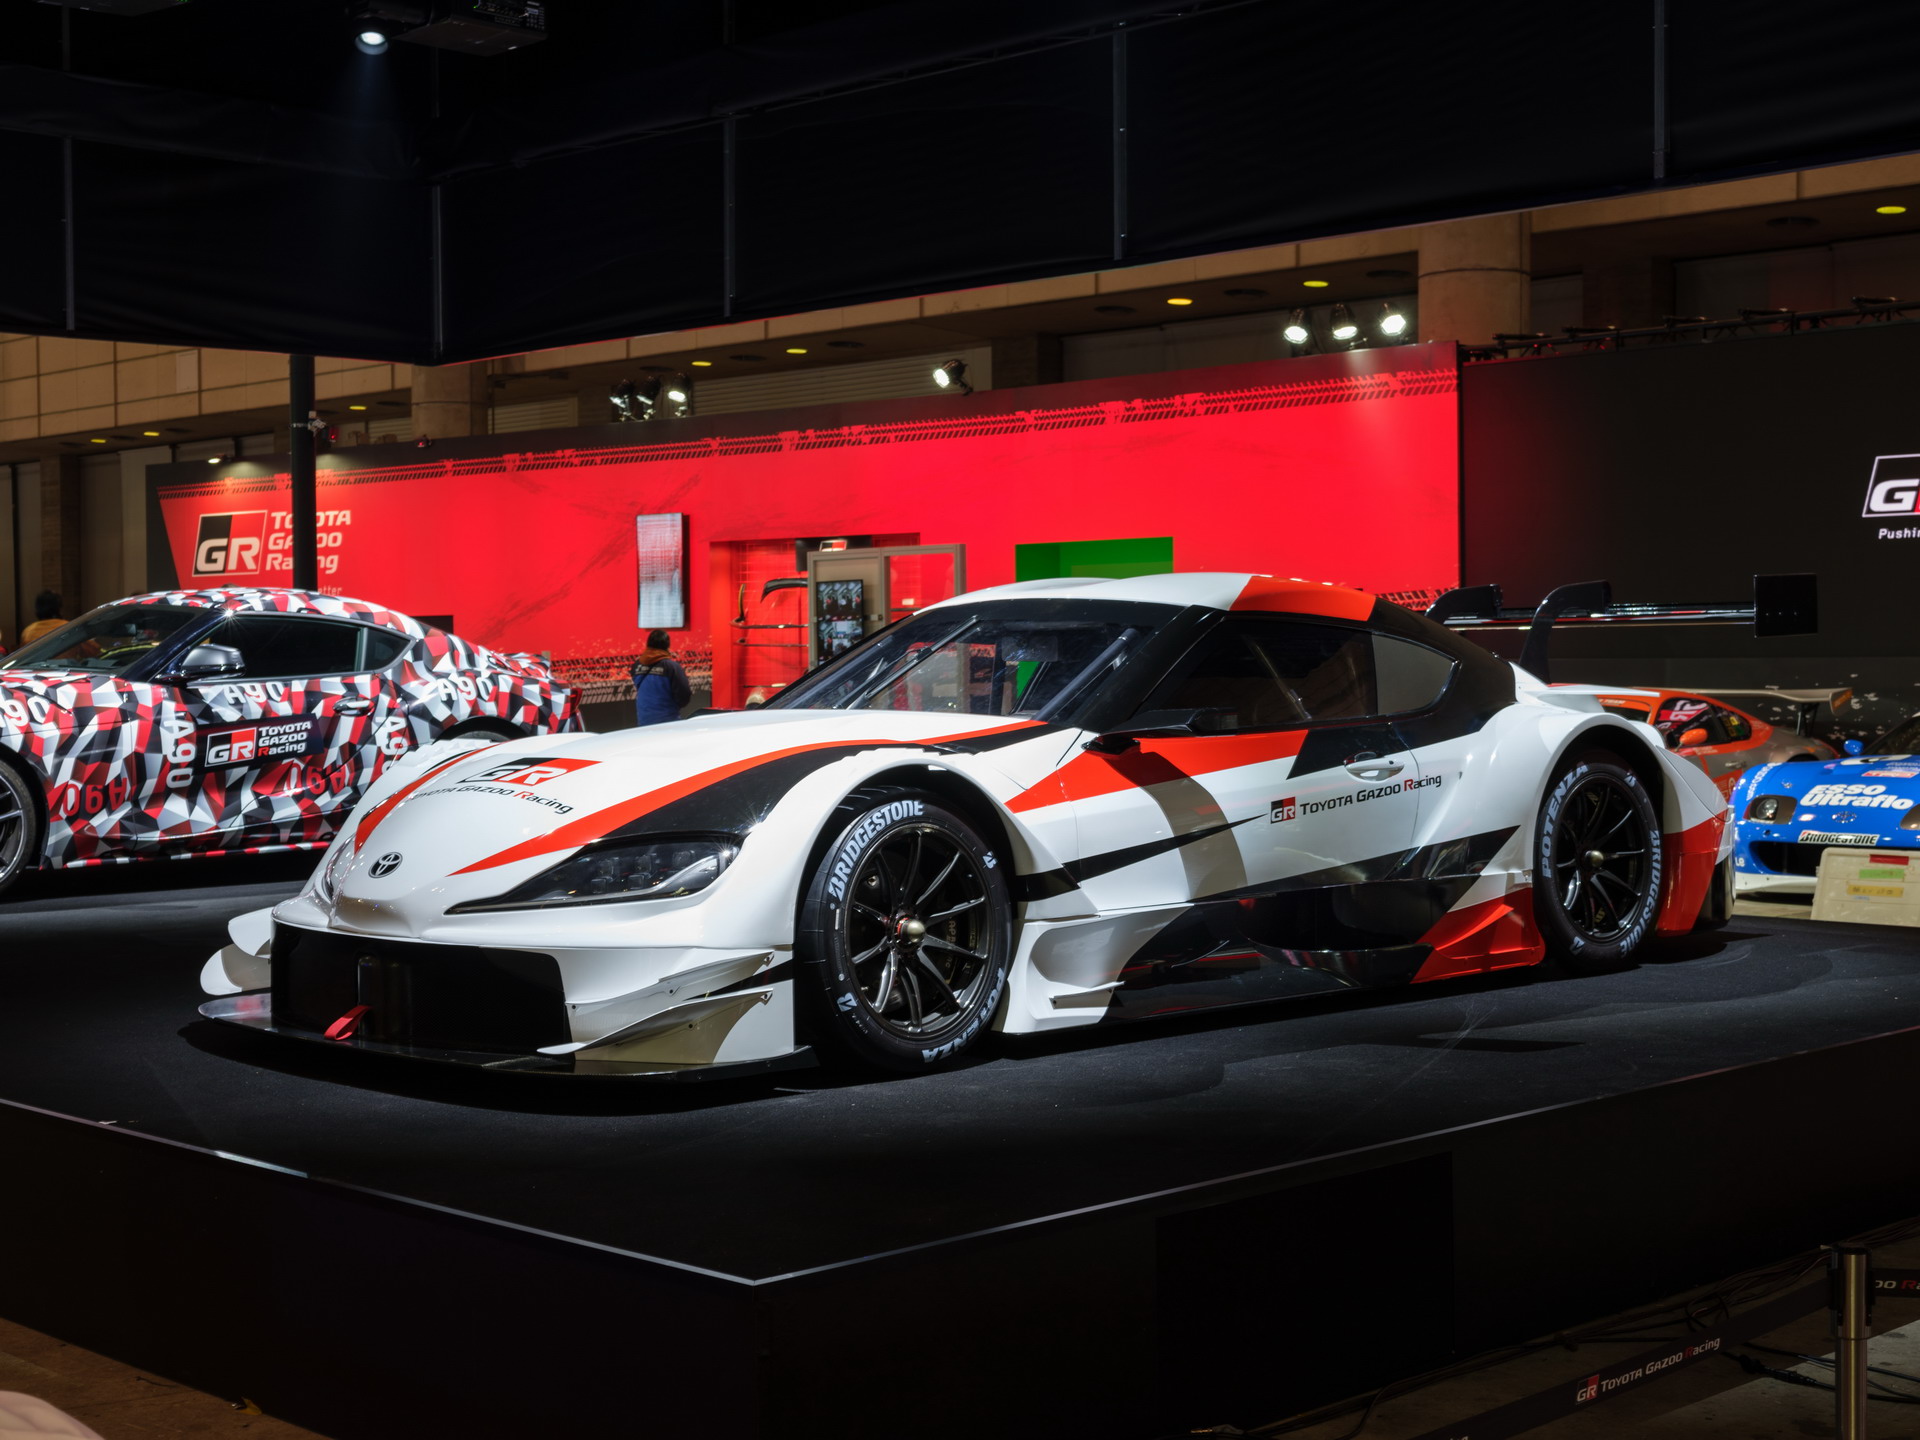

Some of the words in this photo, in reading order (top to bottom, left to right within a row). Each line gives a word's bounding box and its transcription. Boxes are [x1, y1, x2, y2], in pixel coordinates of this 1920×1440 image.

[271, 510, 352, 530] TOOTA
[268, 532, 342, 550] GAOO
[196, 537, 260, 572] GR
[265, 553, 339, 574] Rang
[257, 733, 307, 748] GAZOO
[258, 721, 312, 738] TOYOTA
[207, 741, 255, 764] GR
[257, 743, 307, 758] Racing
[456, 785, 515, 796] GAZOO
[513, 791, 574, 815] Racing
[1271, 805, 1296, 823] GR
[1300, 794, 1353, 816] TOYOTA
[1356, 783, 1401, 802] GAZOO
[1404, 775, 1442, 792] Racing
[1800, 791, 1915, 810] Ultraflo
[1541, 762, 1590, 879] POTENZA
[1799, 831, 1877, 845] BRIDGESTONE
[828, 800, 925, 902] BRIDGESTONE
[1574, 829, 1662, 958] BRIDGESTONE
[1576, 1384, 1598, 1402] GR
[1600, 1367, 1643, 1393] TOYOTA
[1645, 1352, 1683, 1375] GAZOO
[1684, 1337, 1721, 1359] Racing
